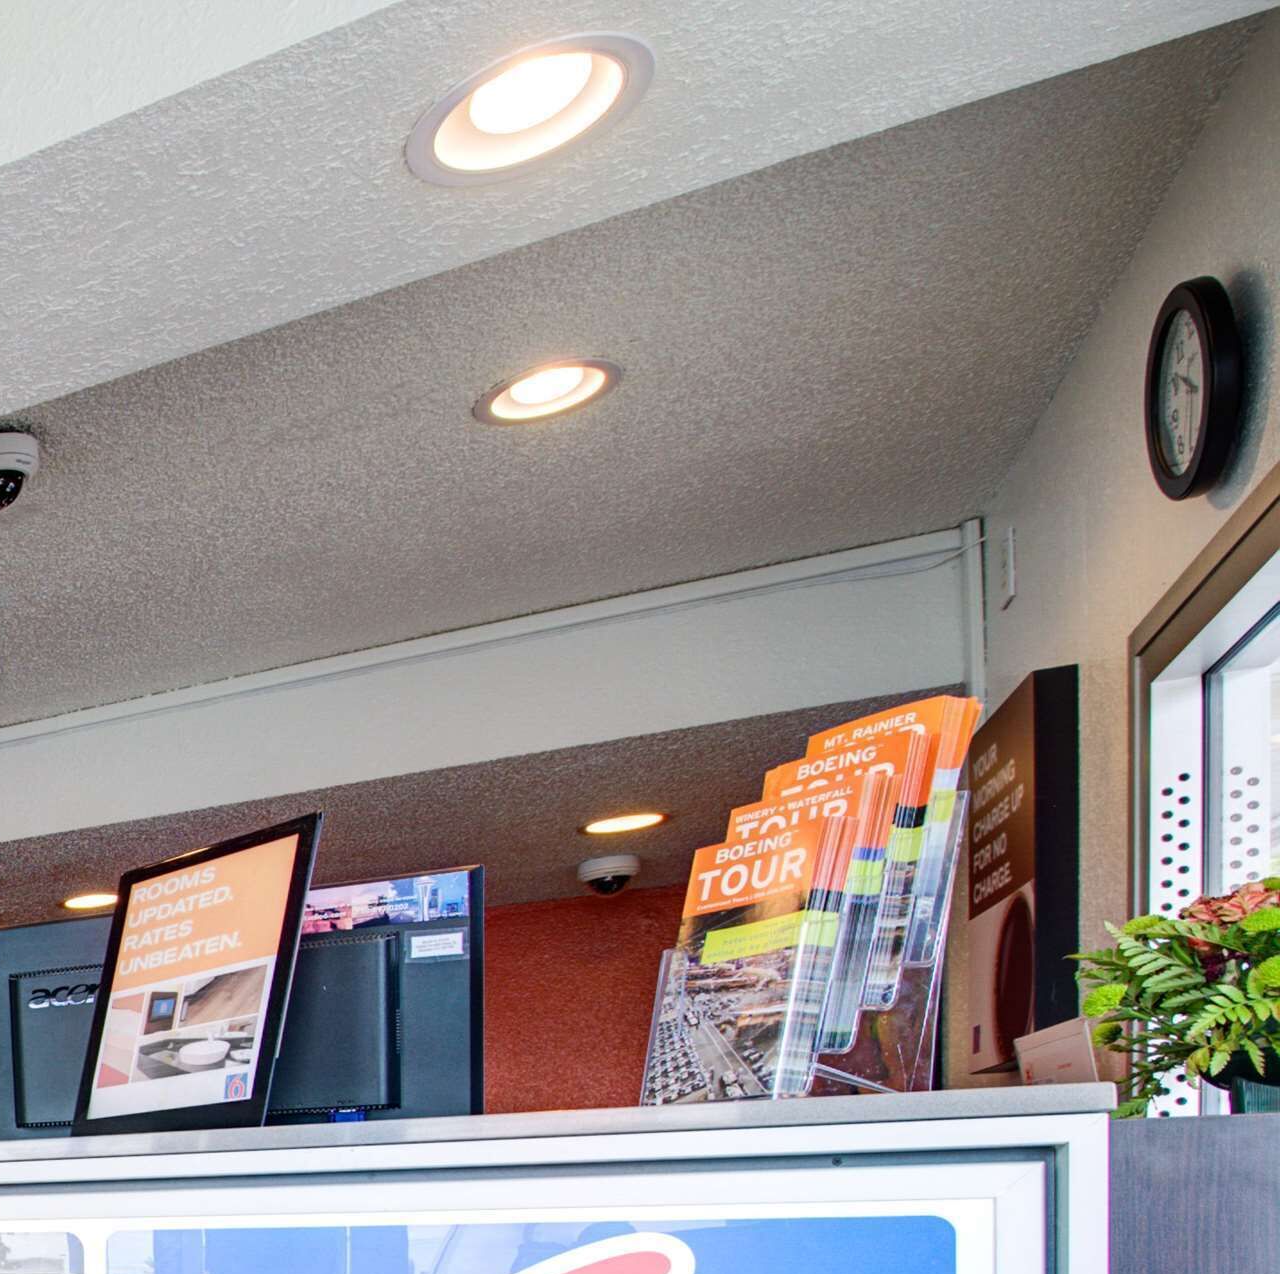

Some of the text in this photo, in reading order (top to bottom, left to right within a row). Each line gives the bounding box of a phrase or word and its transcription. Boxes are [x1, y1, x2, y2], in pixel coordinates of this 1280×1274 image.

[852, 712, 917, 746] RAINIER
[796, 745, 877, 781] BOEING
[973, 743, 998, 781] YOUR
[973, 757, 1016, 813] MORNING
[735, 806, 778, 824] WINERY
[787, 786, 854, 811] WATERFALL
[973, 783, 1025, 844] CHARGE UP
[715, 831, 793, 865] BOEING
[973, 832, 1008, 874] FOR NO
[132, 866, 217, 904] ROOMS
[698, 847, 807, 902] TOUR
[973, 862, 1013, 904] CHARGE
[127, 885, 233, 929] UPDATED.
[120, 930, 243, 977] UNBEATEN.
[124, 920, 194, 953] RATES
[28, 983, 101, 1009] acer
